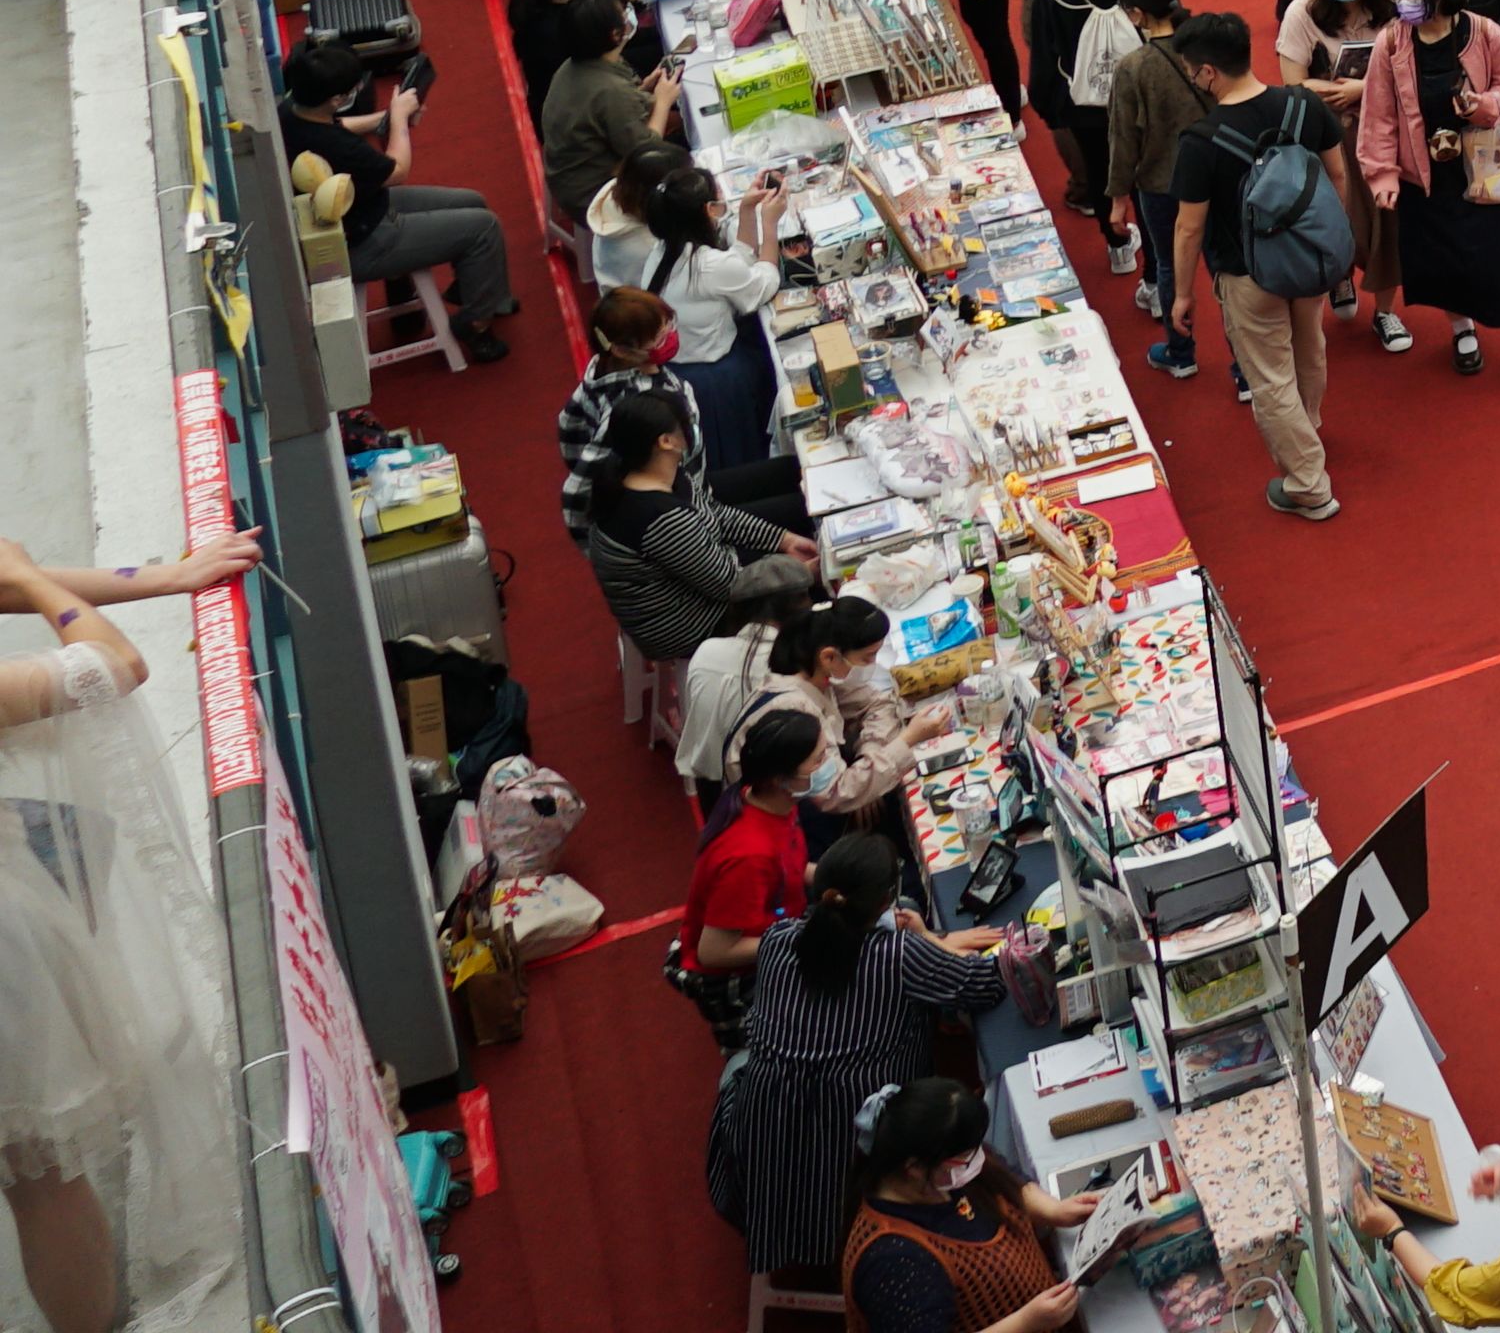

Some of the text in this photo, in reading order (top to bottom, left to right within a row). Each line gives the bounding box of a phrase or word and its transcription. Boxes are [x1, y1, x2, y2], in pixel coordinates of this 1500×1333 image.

[742, 78, 772, 99] plus
[198, 619, 239, 667] FENCE
[203, 676, 246, 720] YOUR
[206, 709, 250, 749] OWN
[1320, 852, 1410, 1016] A
